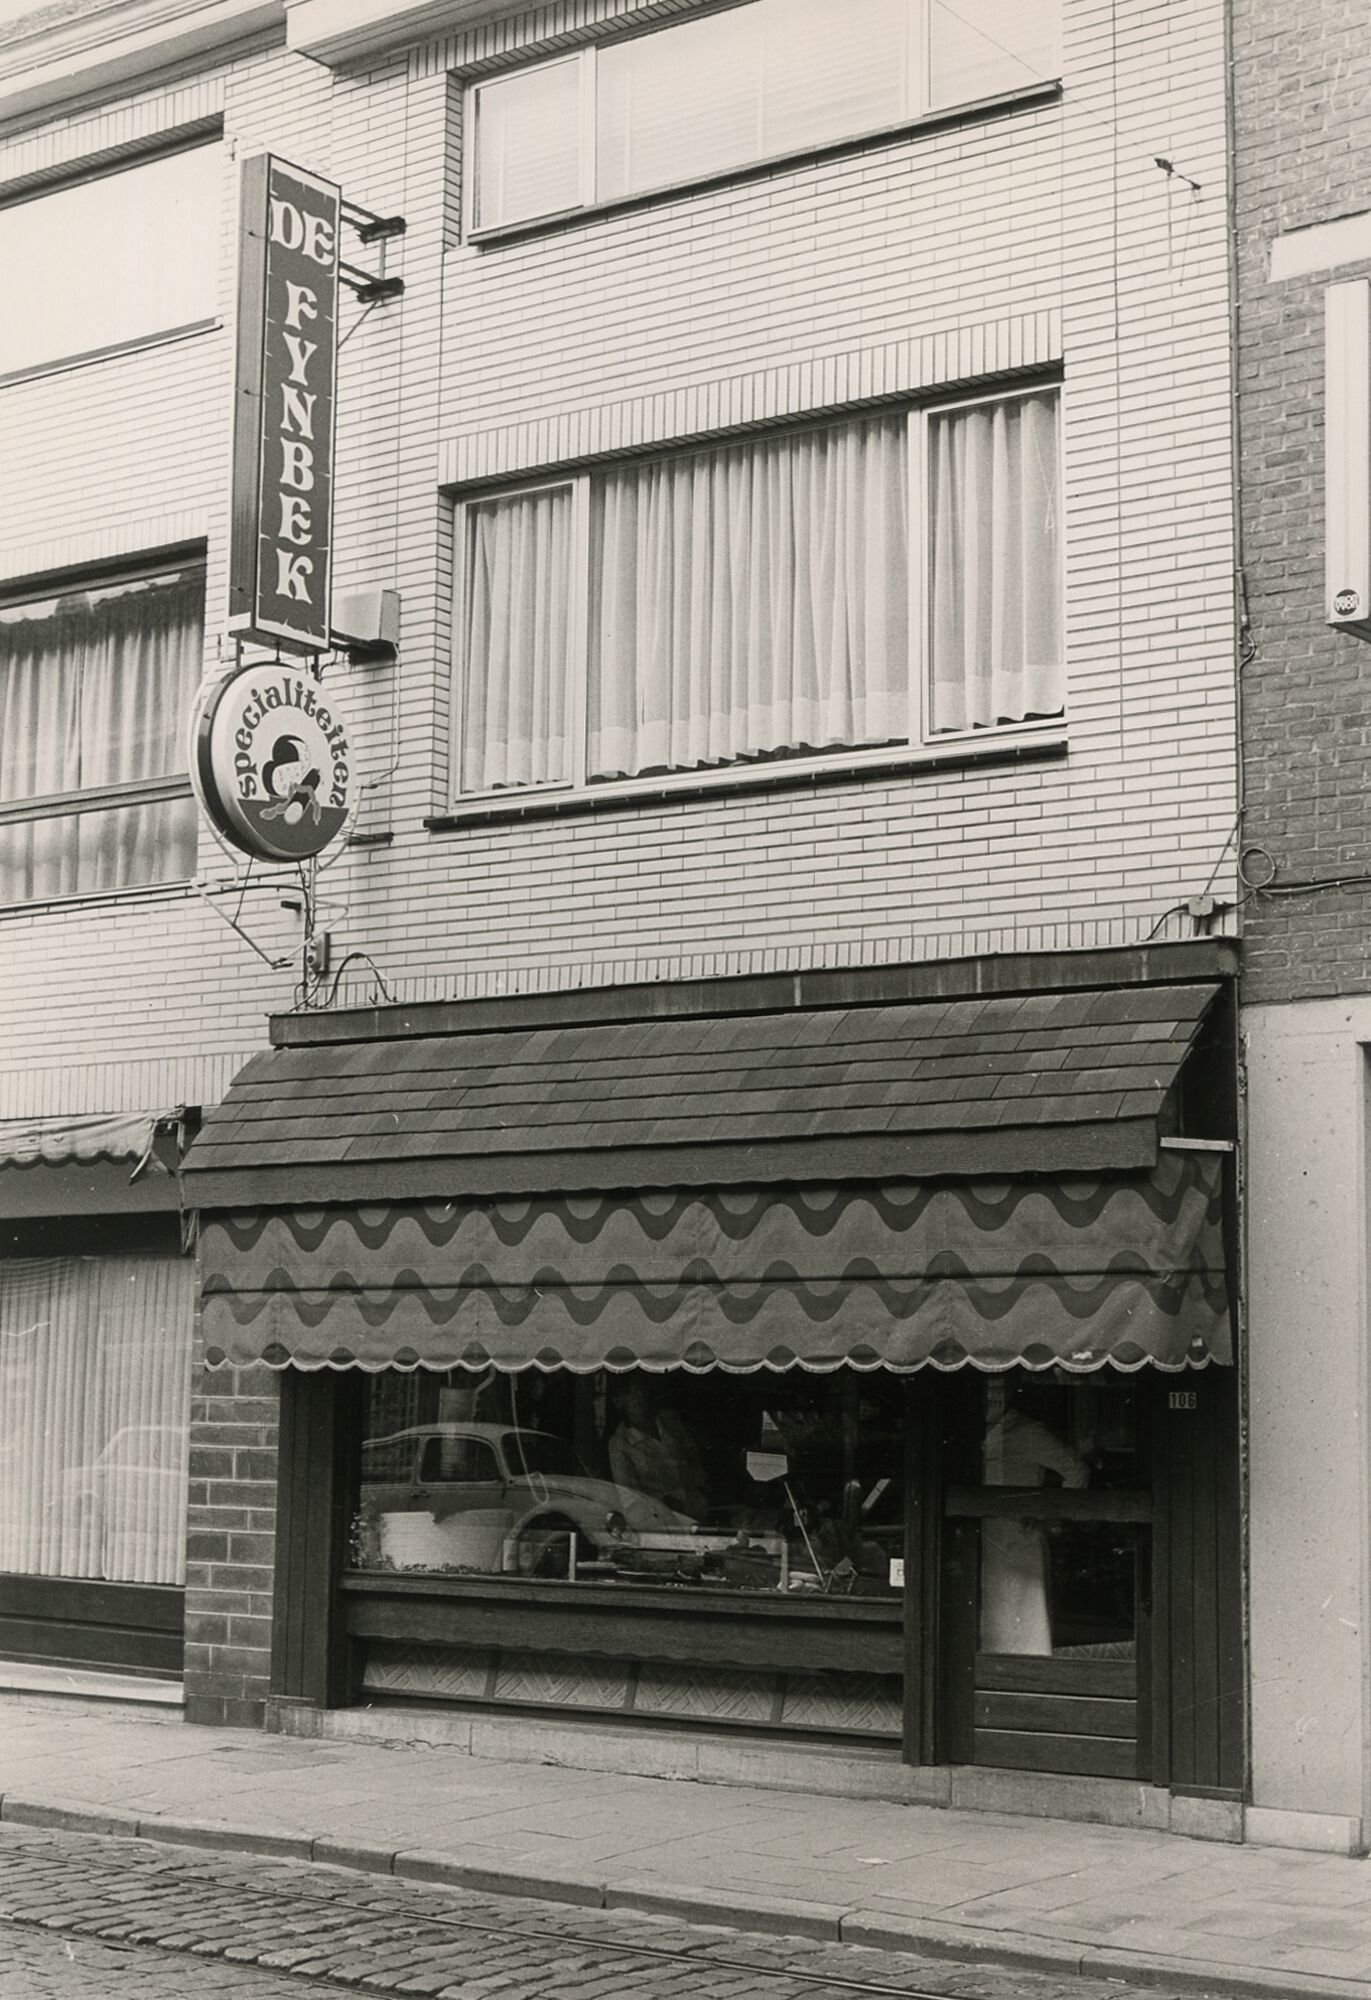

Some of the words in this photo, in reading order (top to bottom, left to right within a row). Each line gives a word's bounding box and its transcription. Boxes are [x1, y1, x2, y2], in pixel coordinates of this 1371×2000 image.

[269, 196, 335, 266] DE
[275, 280, 318, 604] FYNBEK
[234, 677, 350, 808] specialiteiten
[1170, 1392, 1196, 1408] 106
